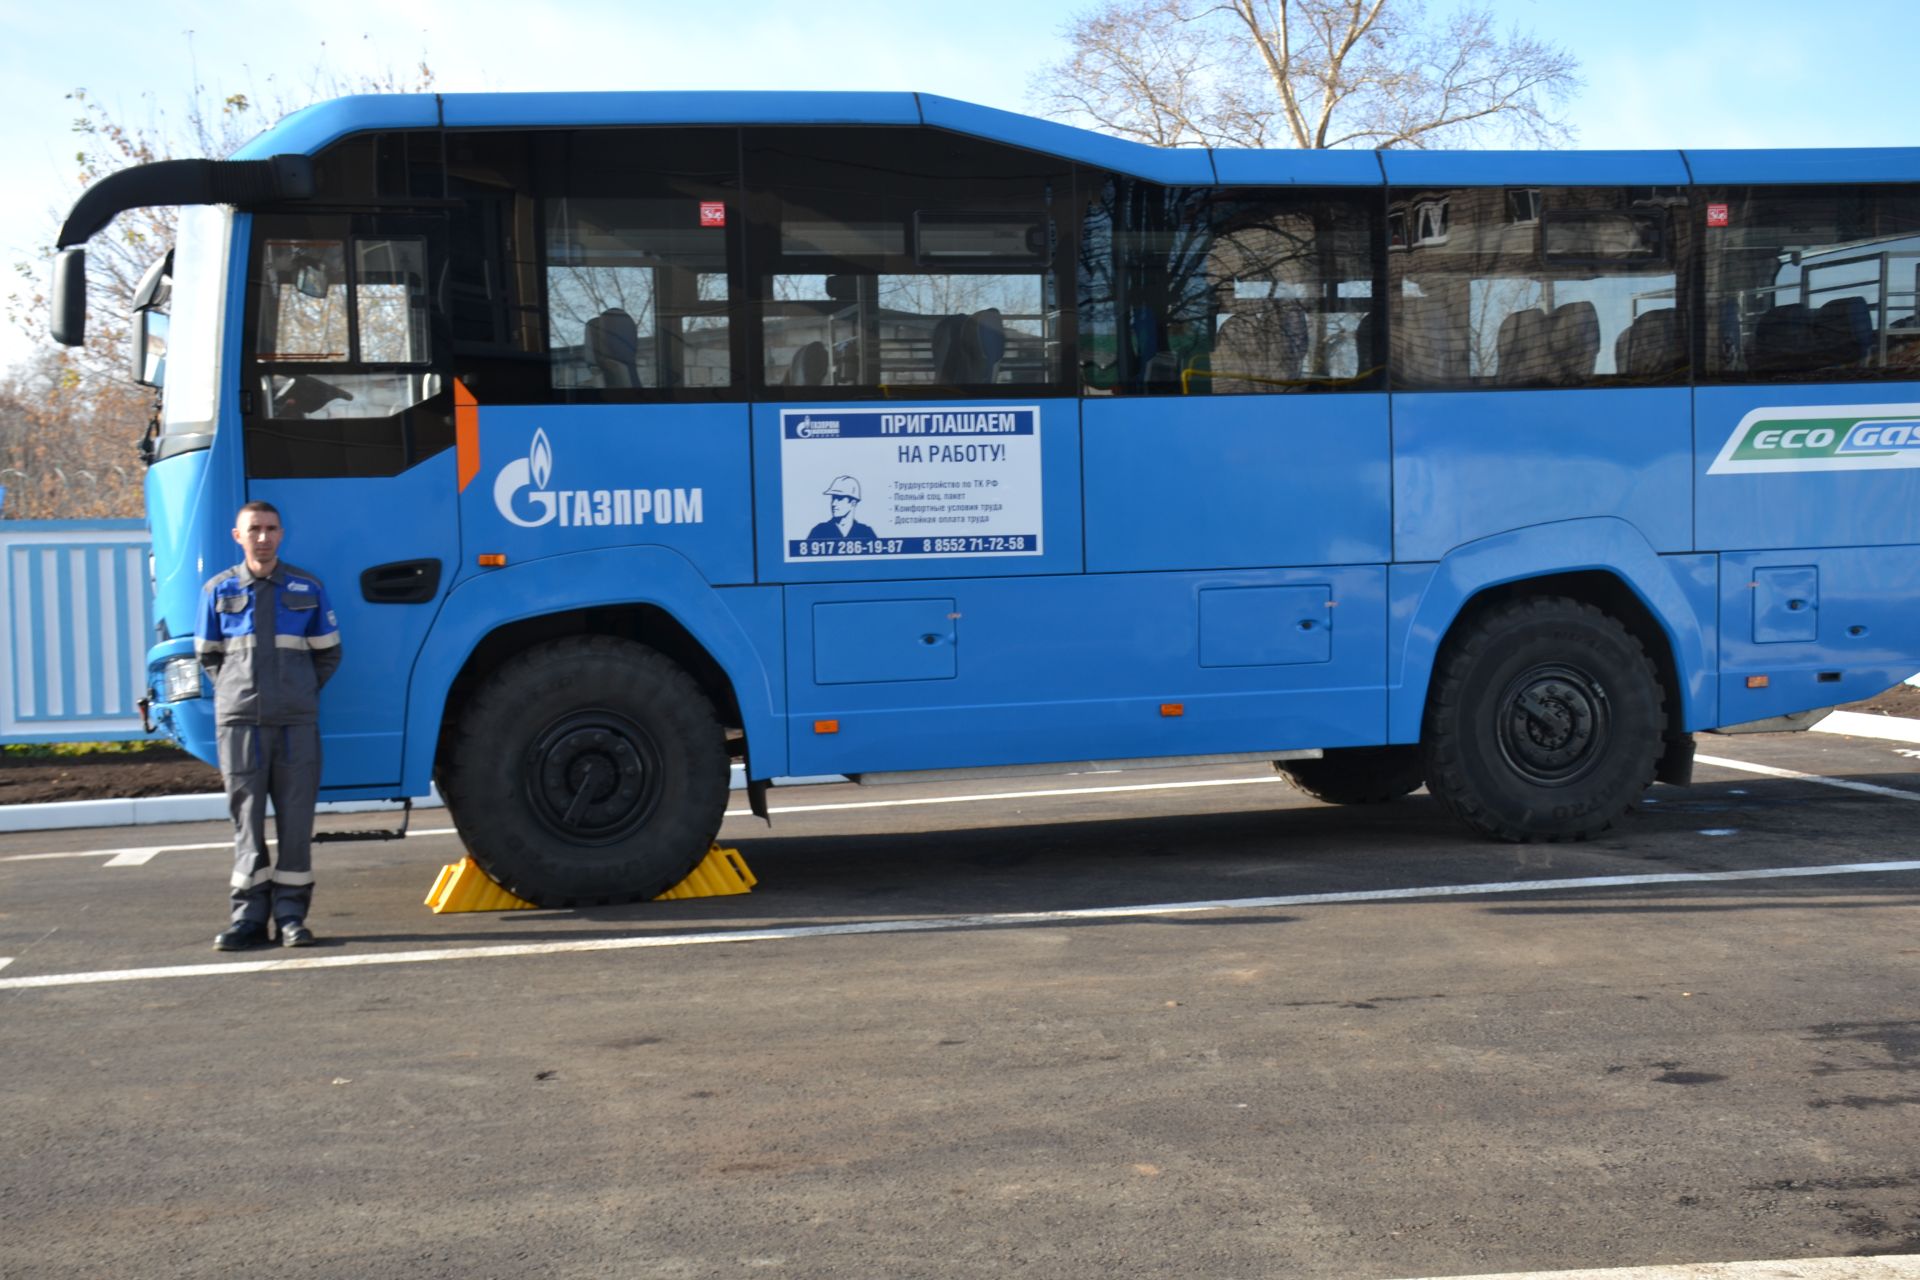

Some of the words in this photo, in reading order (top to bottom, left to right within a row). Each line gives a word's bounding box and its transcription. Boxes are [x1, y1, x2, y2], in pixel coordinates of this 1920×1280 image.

[881, 413, 1015, 434] ПРИГЛАШАЕМ
[1753, 429, 1835, 449] ECO
[898, 445, 923, 463] НА
[929, 444, 1006, 463] РАБОТУ!
[894, 481, 960, 490] Трудоустройство
[974, 480, 984, 488] ТК
[985, 480, 999, 488] РФ
[894, 493, 925, 501] Полный
[559, 488, 702, 527] ГАЗПРОМ
[894, 504, 945, 513] Комфортные
[981, 503, 1003, 512] труда
[894, 516, 937, 525] Достойная
[967, 515, 990, 524] труда
[800, 542, 808, 555] 8
[812, 541, 834, 554] 917
[838, 540, 903, 554] 286-19-87
[923, 538, 931, 552] 8
[934, 537, 966, 551] 8552
[970, 537, 1024, 550] 71-72-58
